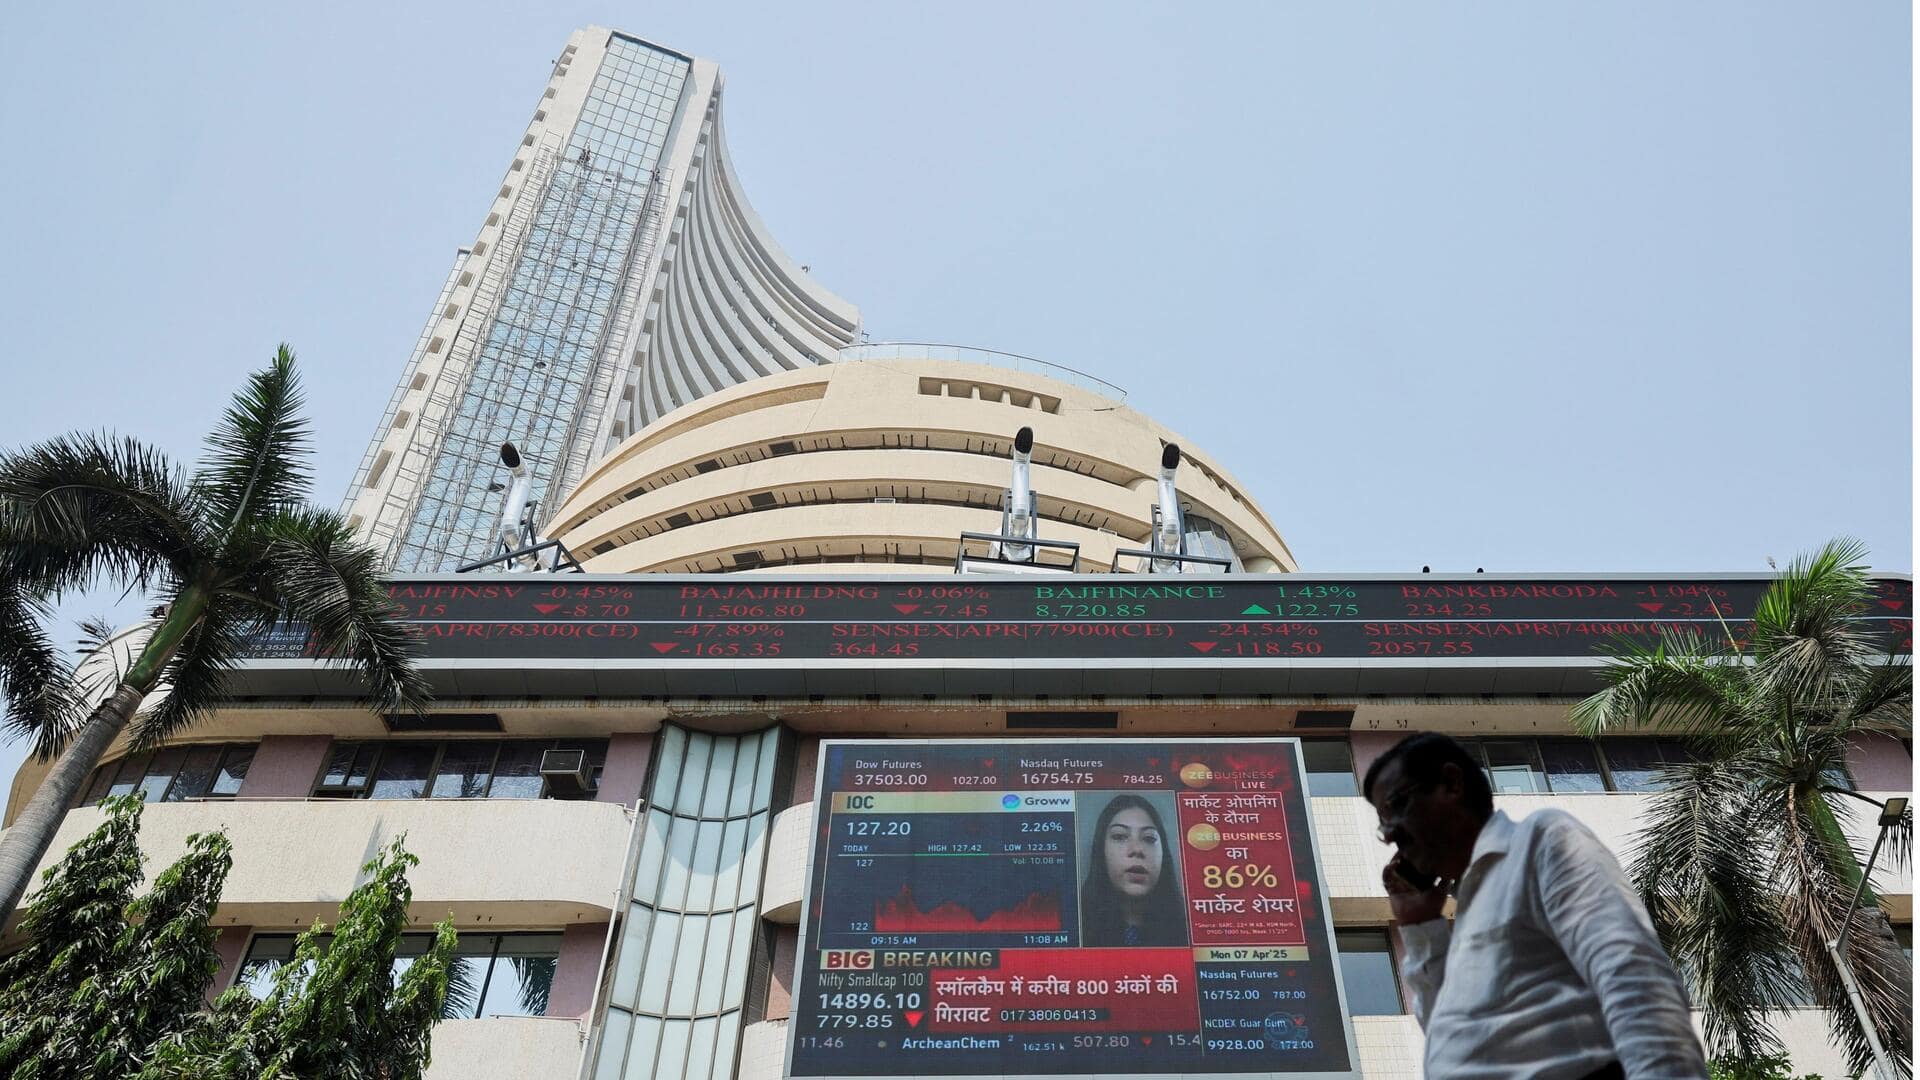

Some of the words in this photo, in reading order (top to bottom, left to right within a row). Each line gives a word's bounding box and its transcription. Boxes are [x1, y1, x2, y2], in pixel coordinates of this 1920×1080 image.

[541, 585, 633, 599] -0.45%
[680, 585, 880, 599] BAJAJHLDNG
[896, 585, 990, 599] -0.06%
[1034, 585, 1226, 599] BAJFINANCE
[1278, 585, 1356, 599] 1.43%
[1400, 585, 1617, 598] BANKBARODA
[1637, 584, 1729, 598] -1.04%
[562, 604, 630, 617] -8.70
[923, 604, 989, 617] -7.45
[1035, 604, 1146, 618] 8,720.85
[1275, 604, 1359, 616] 122.75
[1406, 604, 1493, 616] 234.25
[1669, 602, 1734, 616] -2.45
[673, 623, 785, 638] -47.89%
[1208, 623, 1319, 637] -24.54%
[680, 642, 781, 656] -165.35
[829, 643, 920, 656] 364.45
[1221, 642, 1323, 655] -118.50
[1367, 642, 1473, 655] 2057.55
[855, 760, 878, 769] Dow
[882, 759, 922, 769] Futures
[1020, 759, 1059, 769] Nasdaq
[1063, 758, 1103, 768] Futures
[854, 774, 928, 785] 37503.00
[952, 776, 997, 785] 1027.00
[1022, 772, 1094, 784] 16754.75
[1123, 775, 1163, 784] 784.25
[1241, 781, 1266, 789] LIVE
[846, 795, 875, 809] IOC
[1024, 796, 1071, 806] Groww
[1183, 794, 1222, 808] मार्केट
[1226, 794, 1277, 808] ओपनिंग
[1205, 810, 1219, 824] के
[1222, 810, 1260, 824] दौरान
[847, 821, 911, 836] 127.20
[1021, 822, 1063, 833] 2.26%
[1222, 832, 1283, 841] BUSINESS
[927, 844, 947, 852] HIGH
[952, 844, 982, 852] 127.42
[1004, 843, 1021, 851] LOW
[1028, 843, 1057, 851] 122.35
[1225, 847, 1248, 860] का
[856, 859, 873, 867] 127
[1203, 863, 1278, 888] 86%
[1192, 893, 1246, 914] मार्केट
[1251, 893, 1295, 913] शेयर
[850, 922, 868, 930] 122
[871, 936, 899, 945] 09:15
[902, 936, 917, 944] AM
[1024, 935, 1050, 944] 11:08
[1054, 935, 1068, 943] AM
[826, 951, 872, 968] BIG
[883, 951, 992, 967] BREAKING
[1211, 950, 1231, 959] Mon
[1234, 950, 1247, 959] 07
[818, 973, 843, 989] Nifty
[848, 973, 897, 988] Smallcap
[902, 972, 924, 986] 100
[1200, 970, 1237, 980] Nasdaq
[1240, 970, 1279, 978] Futures
[1010, 975, 1024, 995] में
[1028, 975, 1071, 995] करीब
[1076, 980, 1109, 994] 800
[1114, 974, 1152, 995] अंकों
[1155, 974, 1178, 994] की
[819, 993, 921, 1009] 14896.10
[1203, 990, 1260, 1000] 16752.00
[1273, 991, 1306, 999] 787.00
[934, 1002, 991, 1023] गिरावट
[817, 1014, 893, 1028] 779.85
[1205, 1019, 1236, 1028] NCDEX
[1240, 1019, 1261, 1028] Guar
[1264, 1018, 1288, 1028] Gum
[800, 1036, 844, 1048] 11.46
[902, 1037, 1000, 1049] ArcheanChem
[1073, 1035, 1130, 1048] 507.80
[1207, 1040, 1265, 1050] 9928.00
[1279, 1040, 1314, 1049] 172.00
